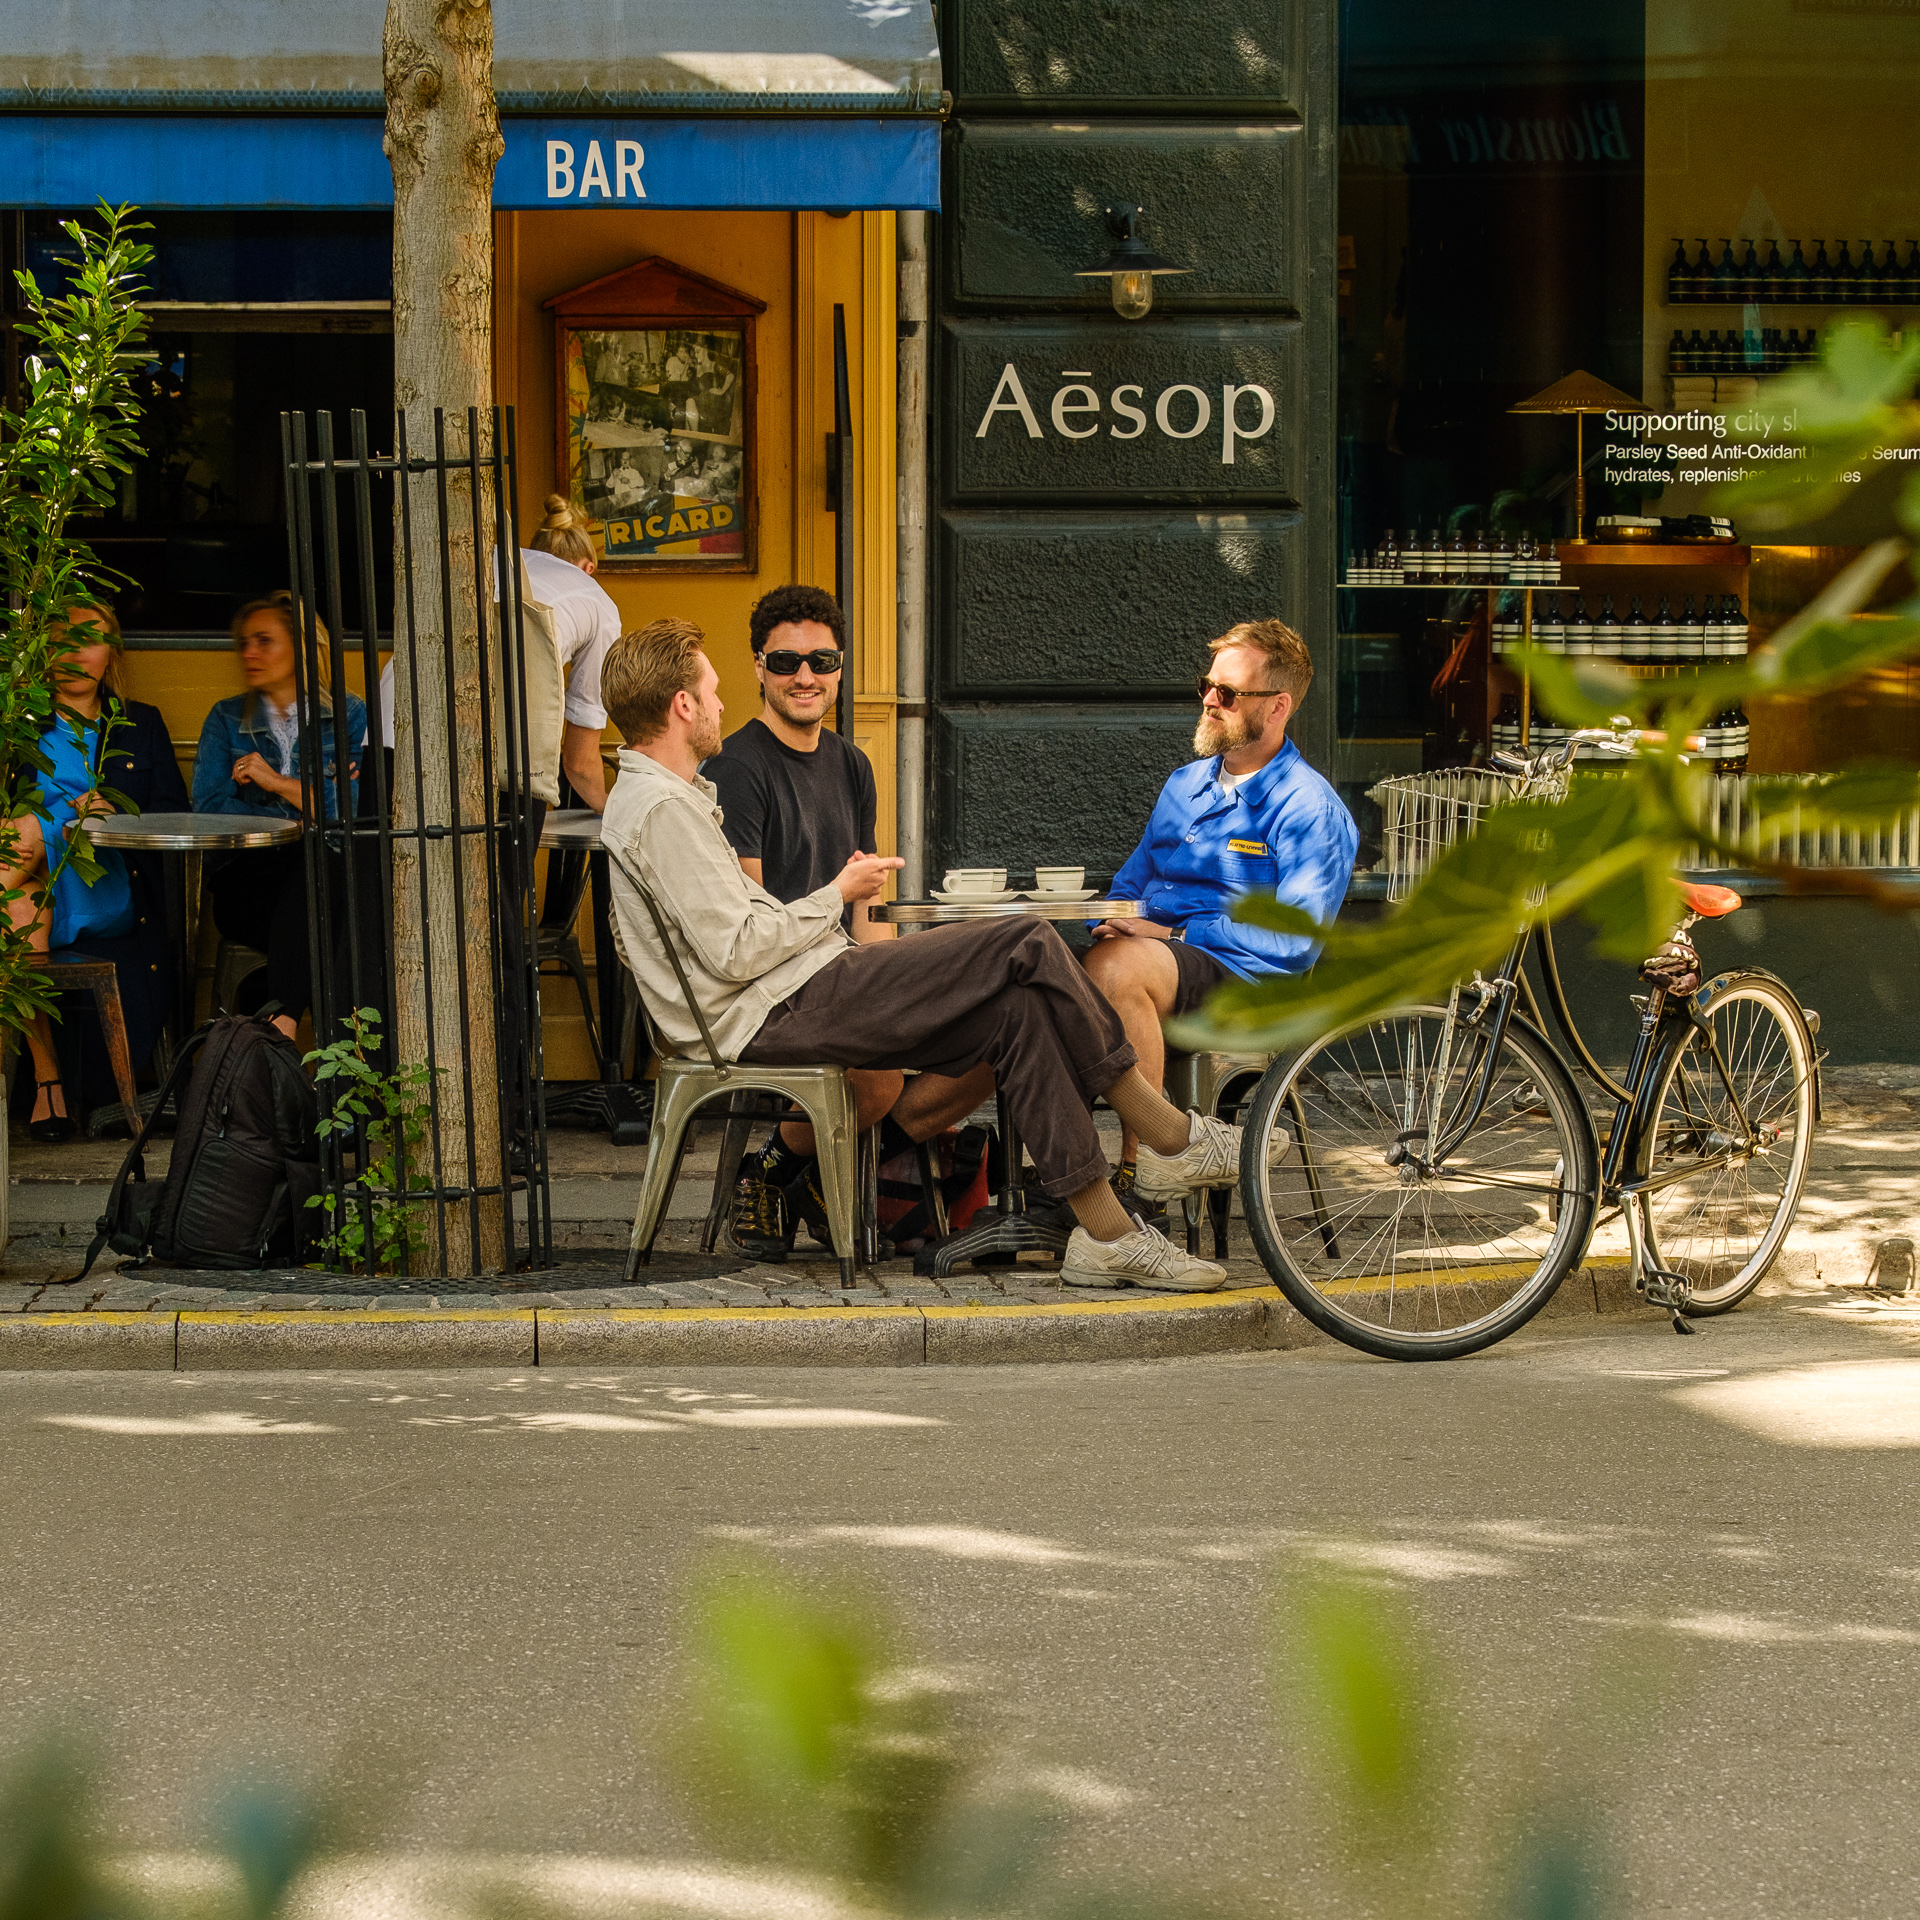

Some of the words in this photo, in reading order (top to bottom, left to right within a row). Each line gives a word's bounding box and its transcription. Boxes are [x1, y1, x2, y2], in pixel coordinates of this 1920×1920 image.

[546, 140, 647, 198] BAR
[975, 363, 1276, 464] Aēsop
[1605, 409, 1727, 438] Supporting
[1735, 409, 1775, 438] city
[1605, 444, 1662, 462] Parsley
[1666, 444, 1708, 459] Seed
[1711, 444, 1807, 459] Anti-Oxidant
[1872, 445, 1920, 460] Serum
[1605, 467, 1674, 485] hydrates,
[608, 504, 734, 545] RICARD
